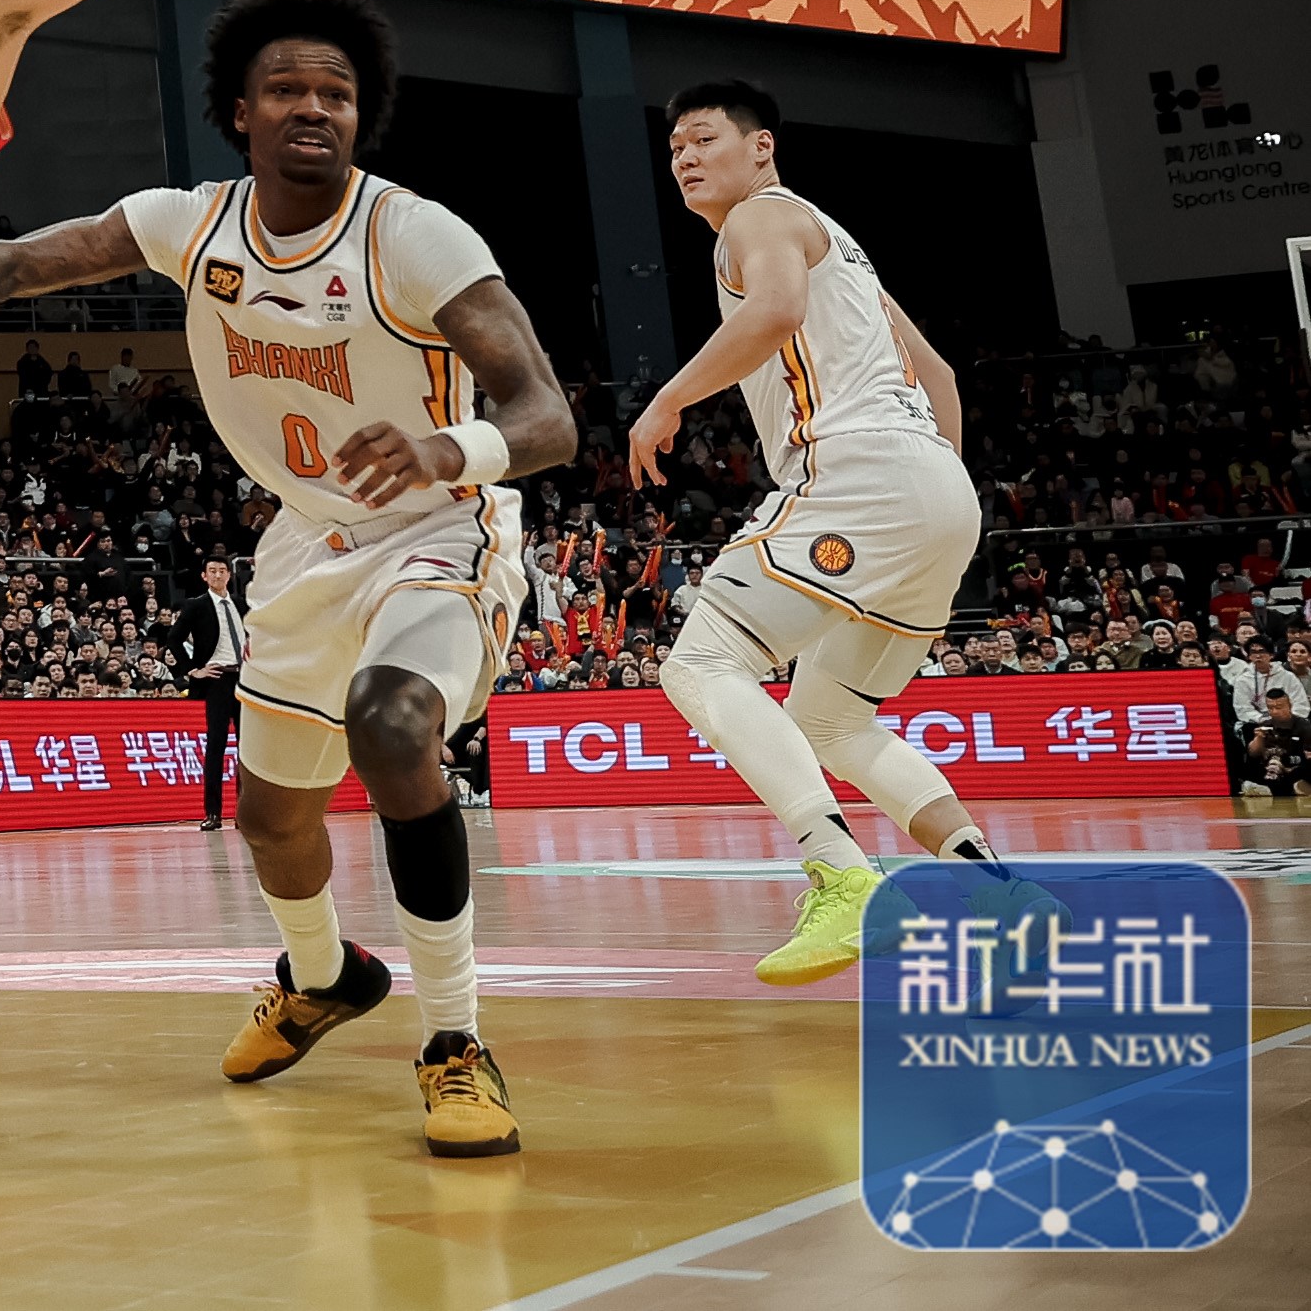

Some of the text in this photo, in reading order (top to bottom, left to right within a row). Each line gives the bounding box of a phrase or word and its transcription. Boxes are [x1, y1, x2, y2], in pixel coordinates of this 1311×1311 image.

[1164, 132, 1304, 165] 黄龙体育心
[1168, 160, 1282, 184] Huanglong
[1173, 181, 1311, 209] Sports Centre
[215, 310, 355, 406] SHANXI
[281, 412, 329, 478] 0
[508, 720, 670, 774] TCL
[1045, 702, 1199, 763] 华星
[34, 734, 112, 792] 华星
